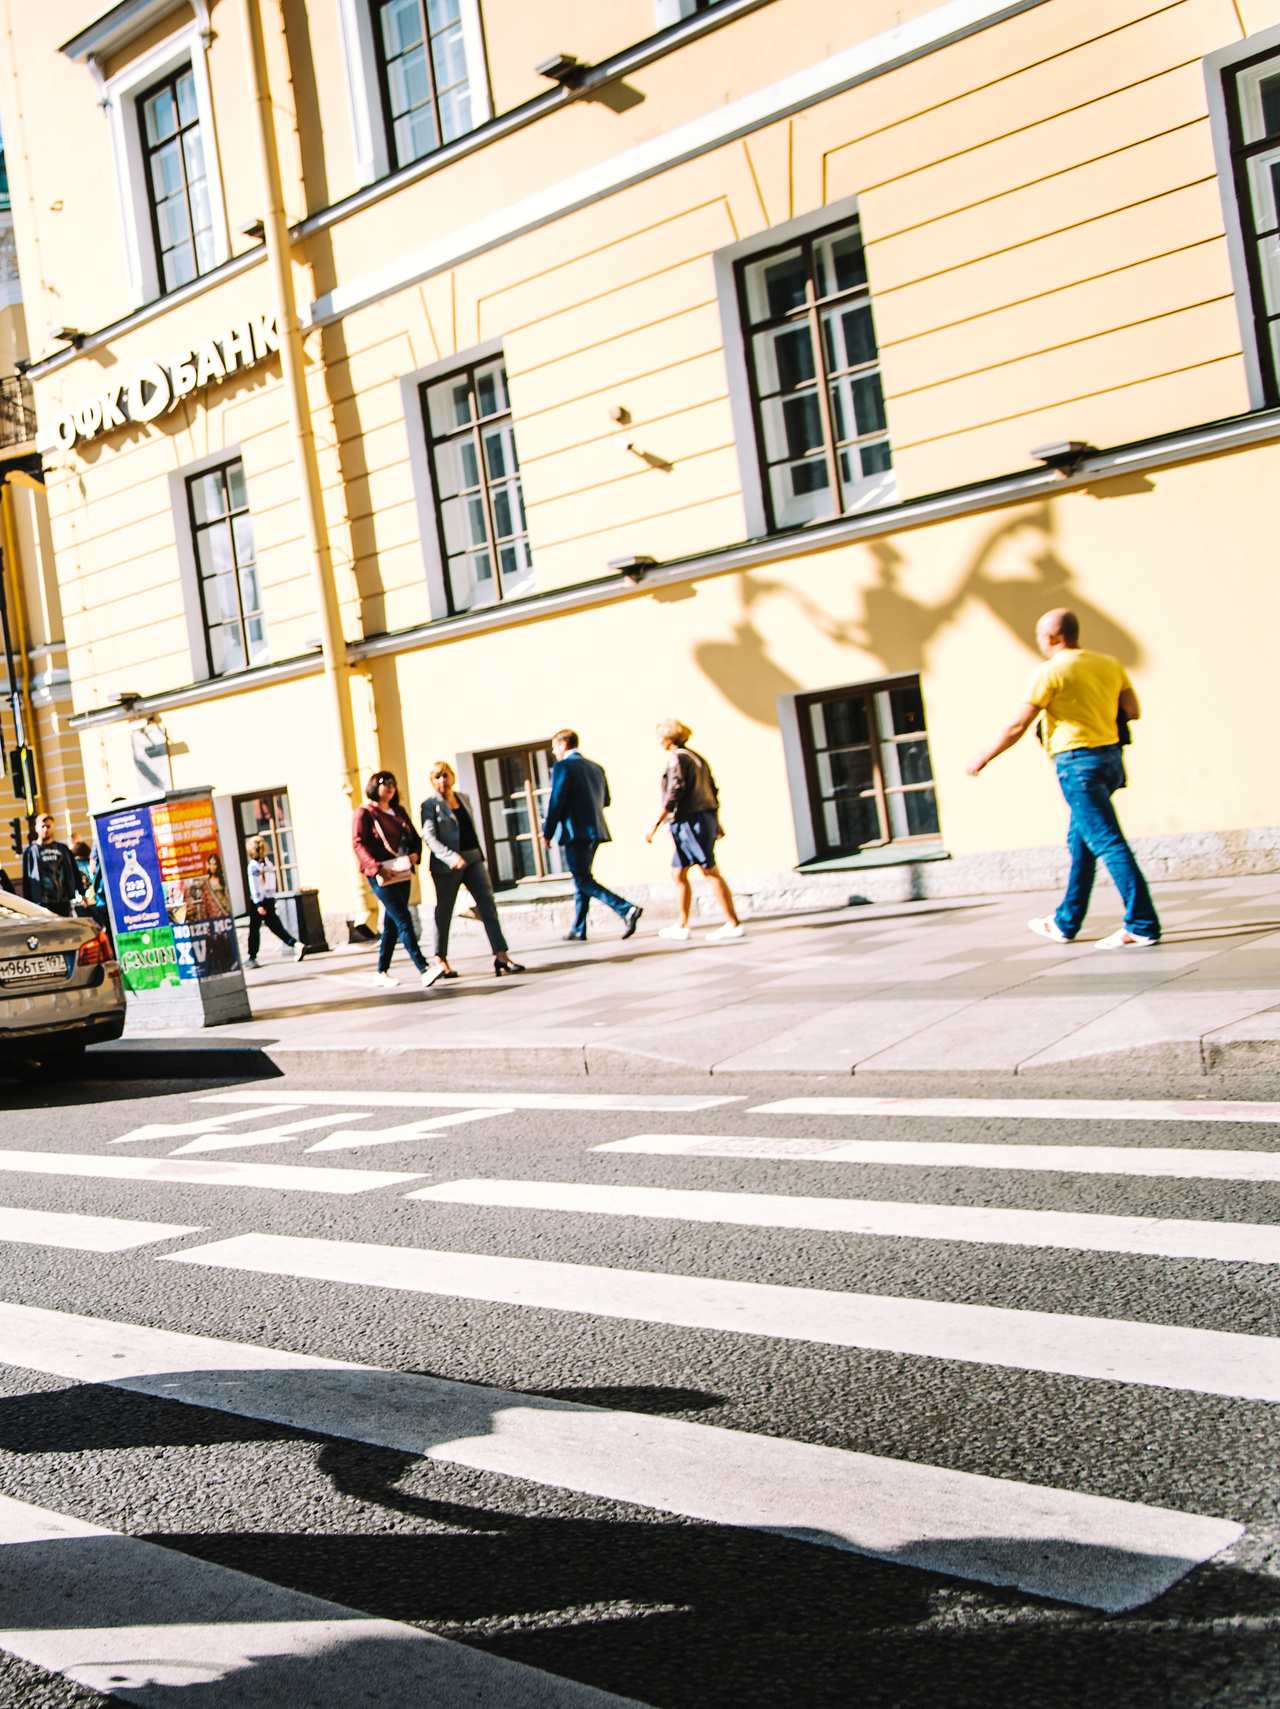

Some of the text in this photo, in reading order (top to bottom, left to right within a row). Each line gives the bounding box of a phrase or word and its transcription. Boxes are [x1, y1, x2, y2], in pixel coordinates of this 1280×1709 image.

[54, 313, 281, 450] ОФК БАНК
[173, 921, 211, 939] NOIZE
[213, 918, 233, 933] MC
